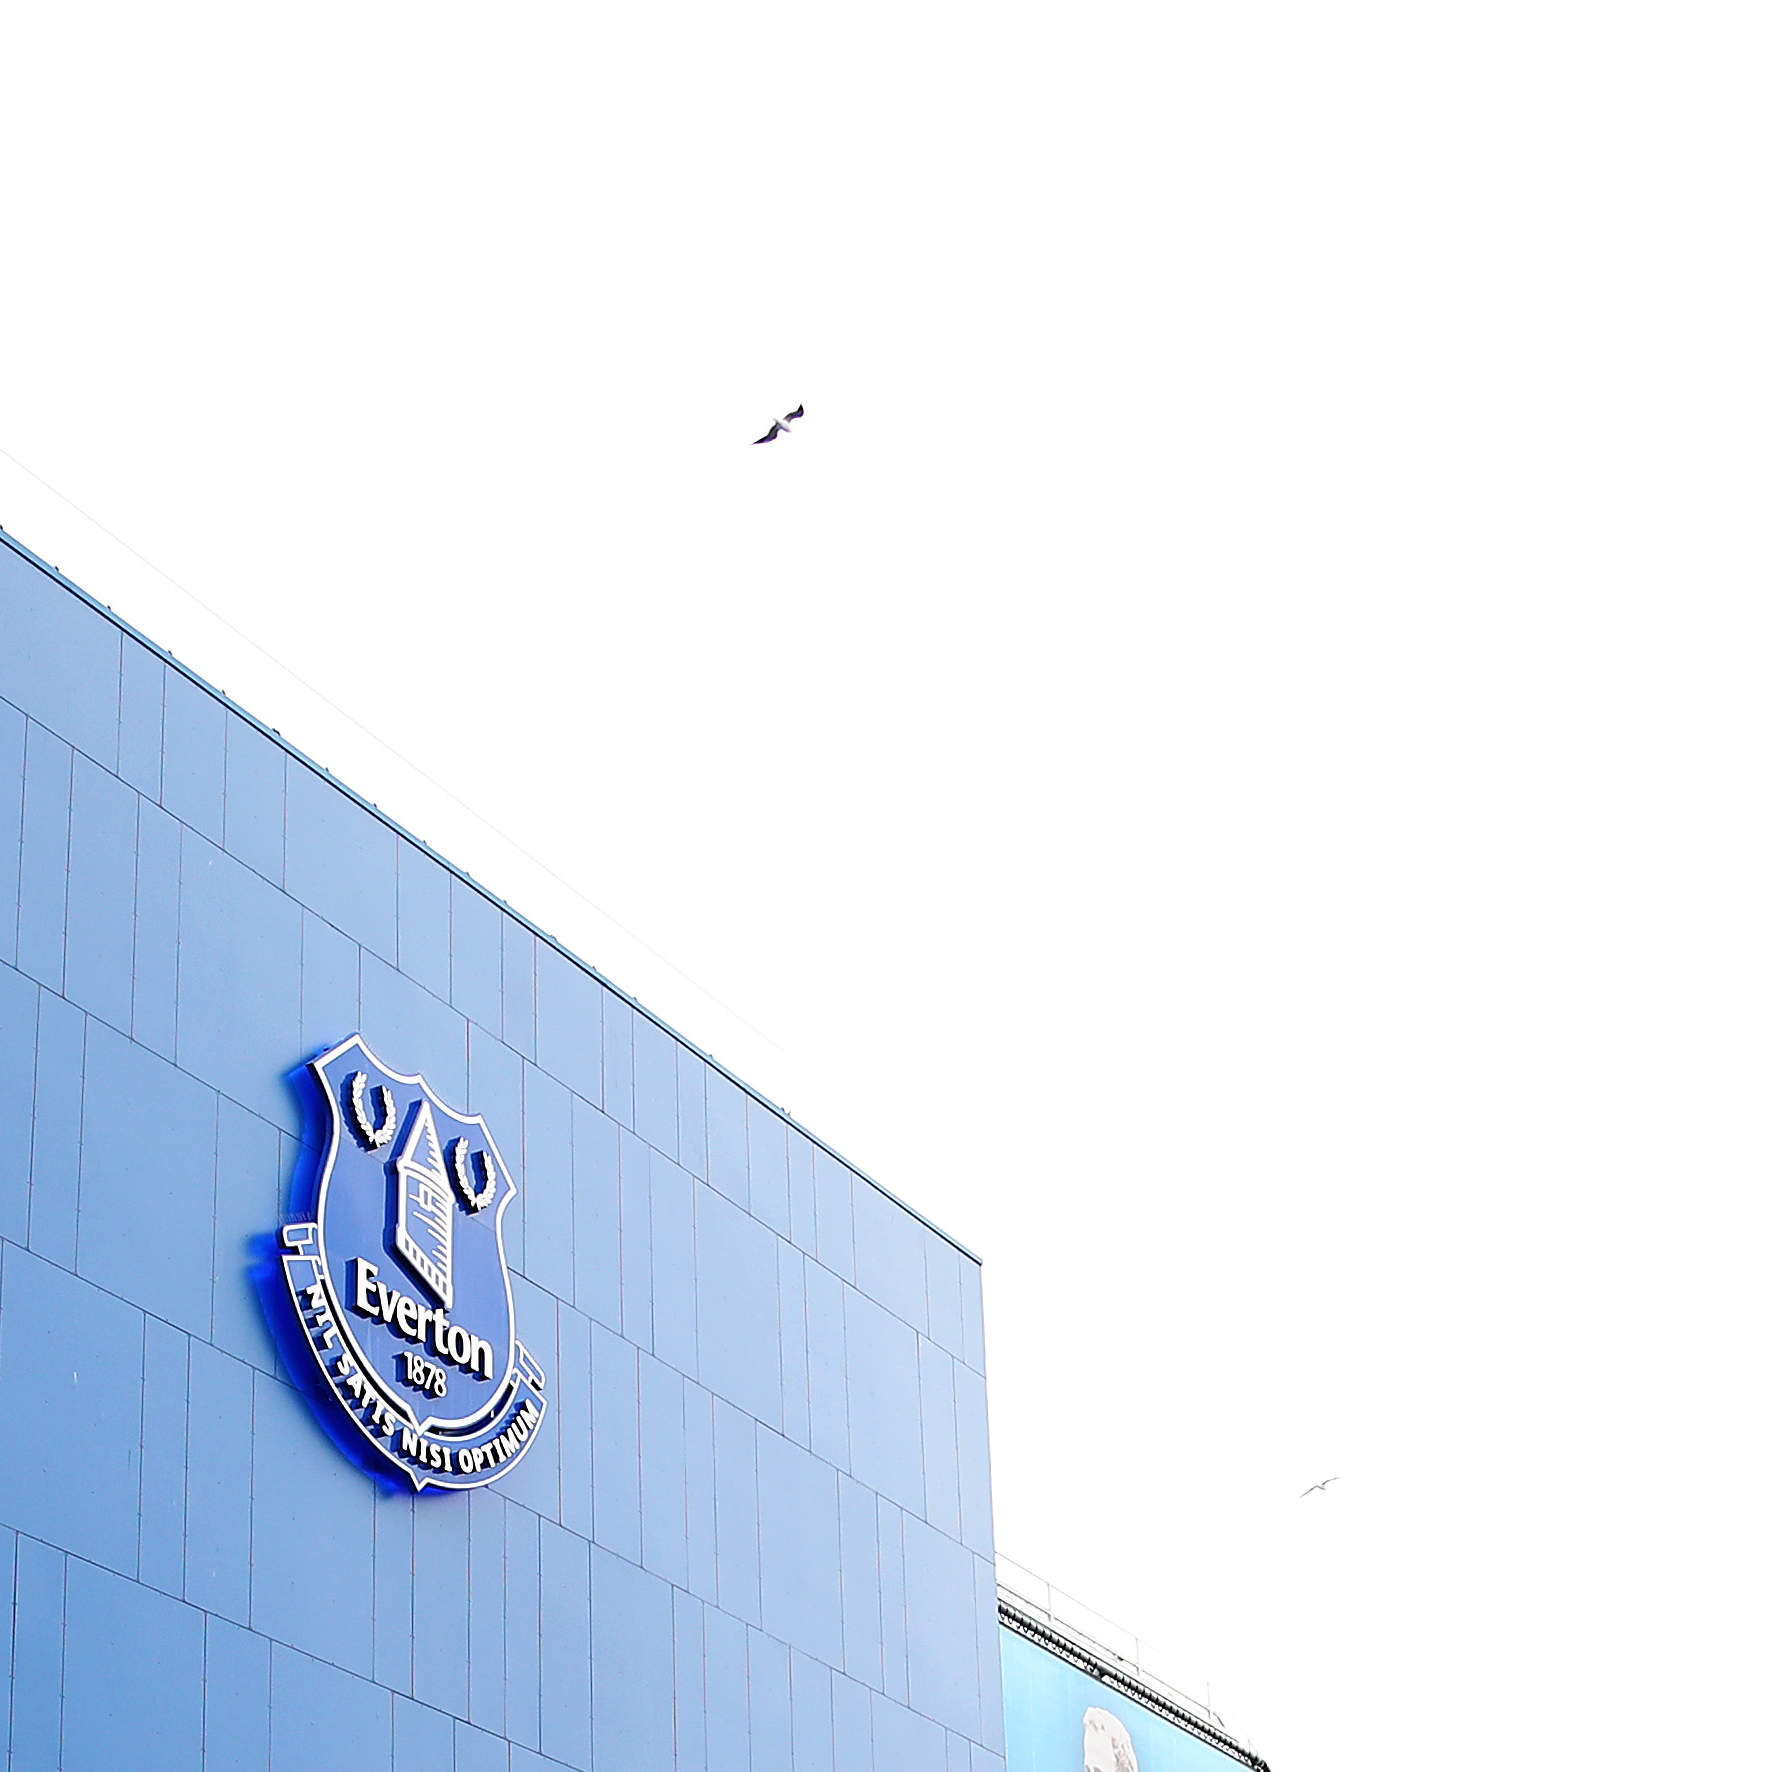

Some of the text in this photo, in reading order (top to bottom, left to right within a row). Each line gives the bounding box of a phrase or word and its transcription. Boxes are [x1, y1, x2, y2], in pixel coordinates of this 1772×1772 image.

[307, 1282, 538, 1475] NIL SATIS NISI OPTIMUM
[356, 1256, 494, 1380] Everton
[403, 1351, 447, 1398] 1878
